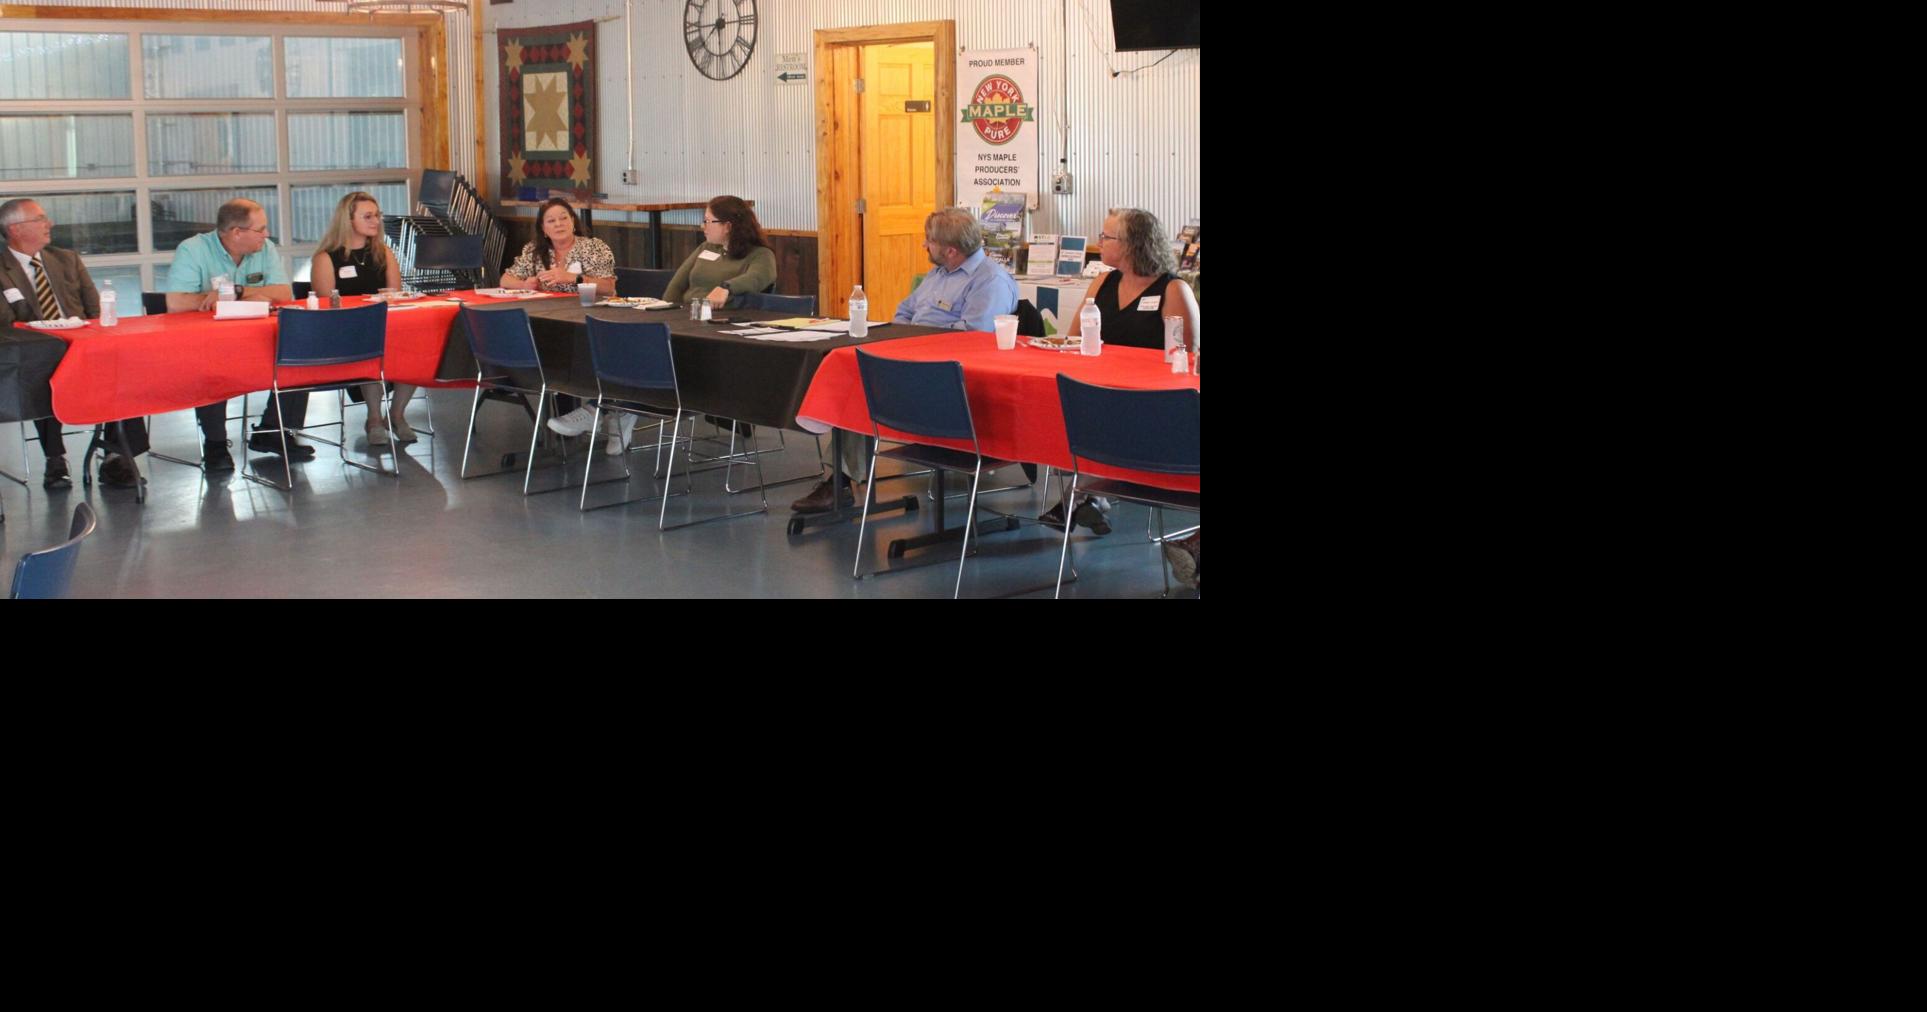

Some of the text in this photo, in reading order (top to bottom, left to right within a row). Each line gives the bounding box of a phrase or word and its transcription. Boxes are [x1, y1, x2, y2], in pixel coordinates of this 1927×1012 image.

[968, 58, 1025, 68] PROUD MEMBER
[976, 80, 1020, 104] NEW YORK
[968, 104, 1027, 117] MAPLE
[983, 126, 1011, 140] PURE
[992, 153, 1017, 161] MAPLE
[973, 178, 1021, 186] ASSOCIATION
